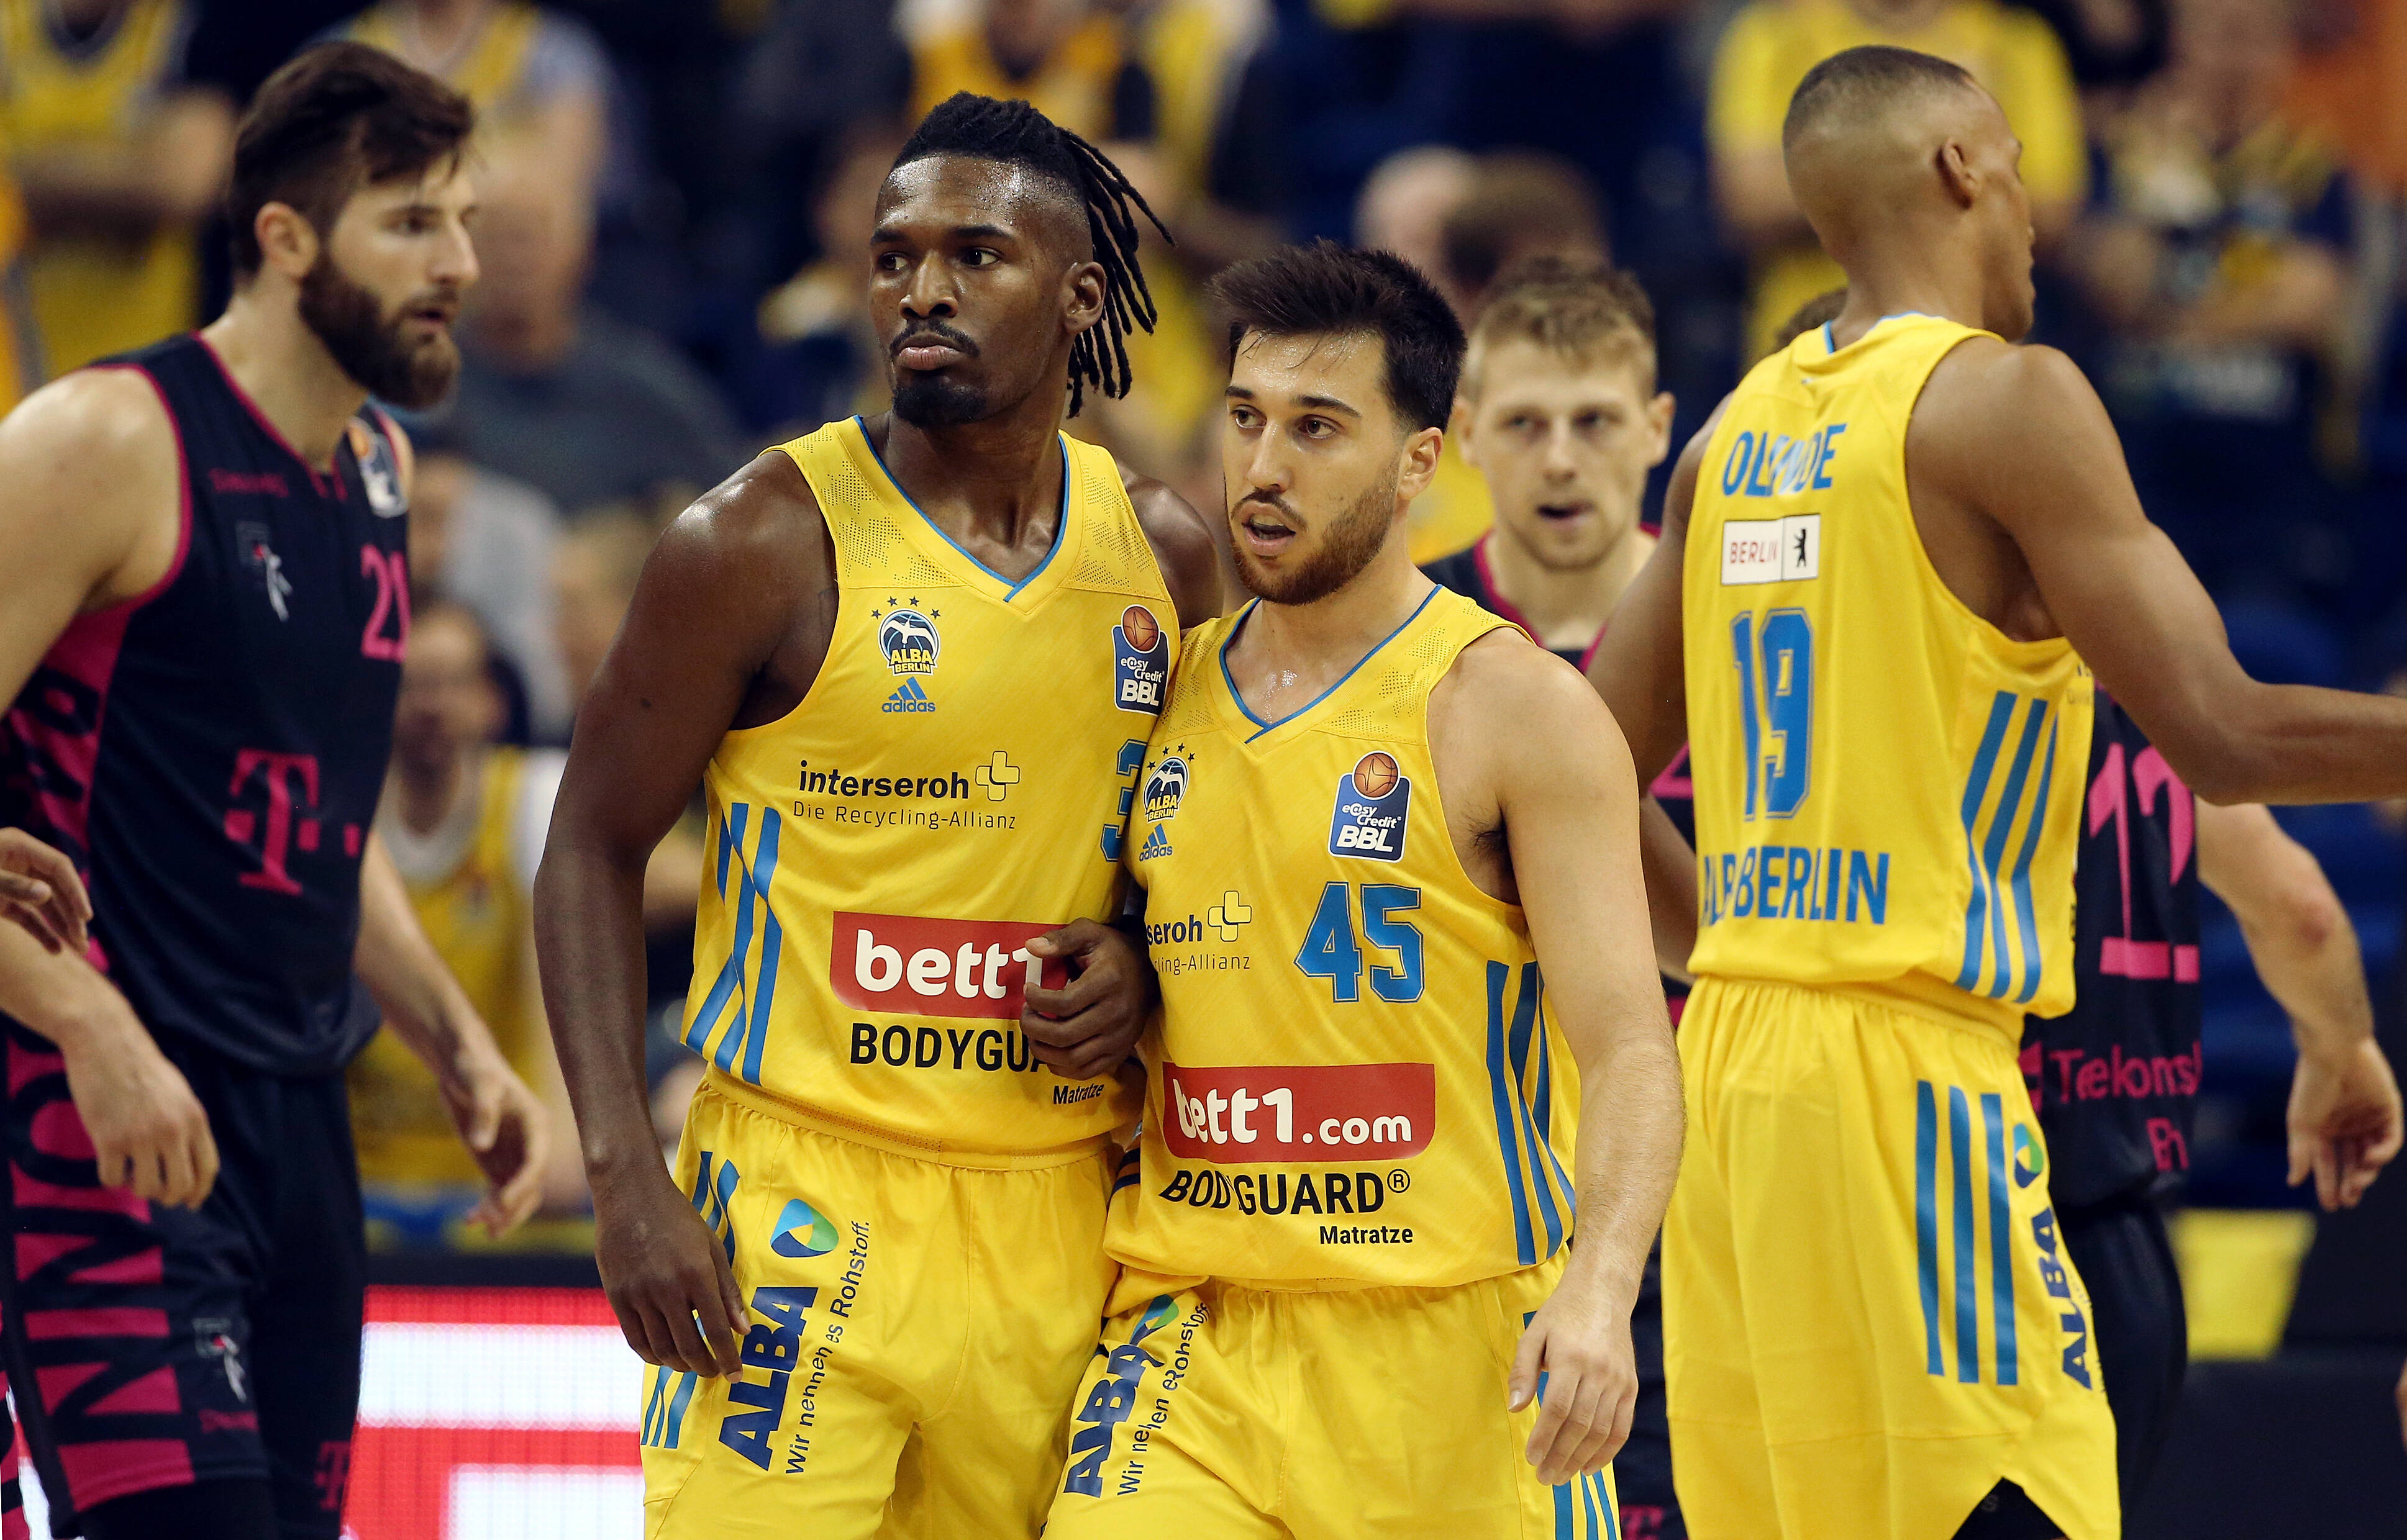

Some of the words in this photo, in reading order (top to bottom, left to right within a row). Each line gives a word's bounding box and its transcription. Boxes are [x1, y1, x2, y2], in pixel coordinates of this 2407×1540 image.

[890, 649, 934, 665] ALBA
[894, 663, 930, 673] BERLIN
[1121, 656, 1149, 671] e@sy
[881, 699, 936, 713] adidas
[1121, 679, 1159, 707] BBL
[1729, 607, 1814, 822] 19
[799, 759, 969, 799] interseroh
[794, 801, 824, 818] Die
[835, 806, 1016, 830] Recycling-Allianz
[1147, 795, 1177, 813] ALBA
[1149, 808, 1174, 820] BERLIN
[1342, 803, 1378, 818] e@sy
[1336, 825, 1393, 853] BBL
[1139, 846, 1173, 862] adidas
[1734, 846, 1890, 925] BERLIN
[1147, 915, 1202, 946] seroh
[1294, 882, 1424, 1002] 45
[855, 929, 1043, 999] bett1
[1053, 1083, 1104, 1105] Matratze
[1173, 1079, 1412, 1145] bett1.com
[1319, 1226, 1413, 1244] Matratze
[830, 1220, 870, 1318] Rohstoff.
[2031, 1207, 2093, 1391] ALBA
[826, 1324, 844, 1344] es
[719, 1287, 819, 1472] ALBA
[799, 1346, 834, 1428] nennen
[786, 1434, 810, 1474] Wir
[1117, 1461, 1144, 1496] Wir
